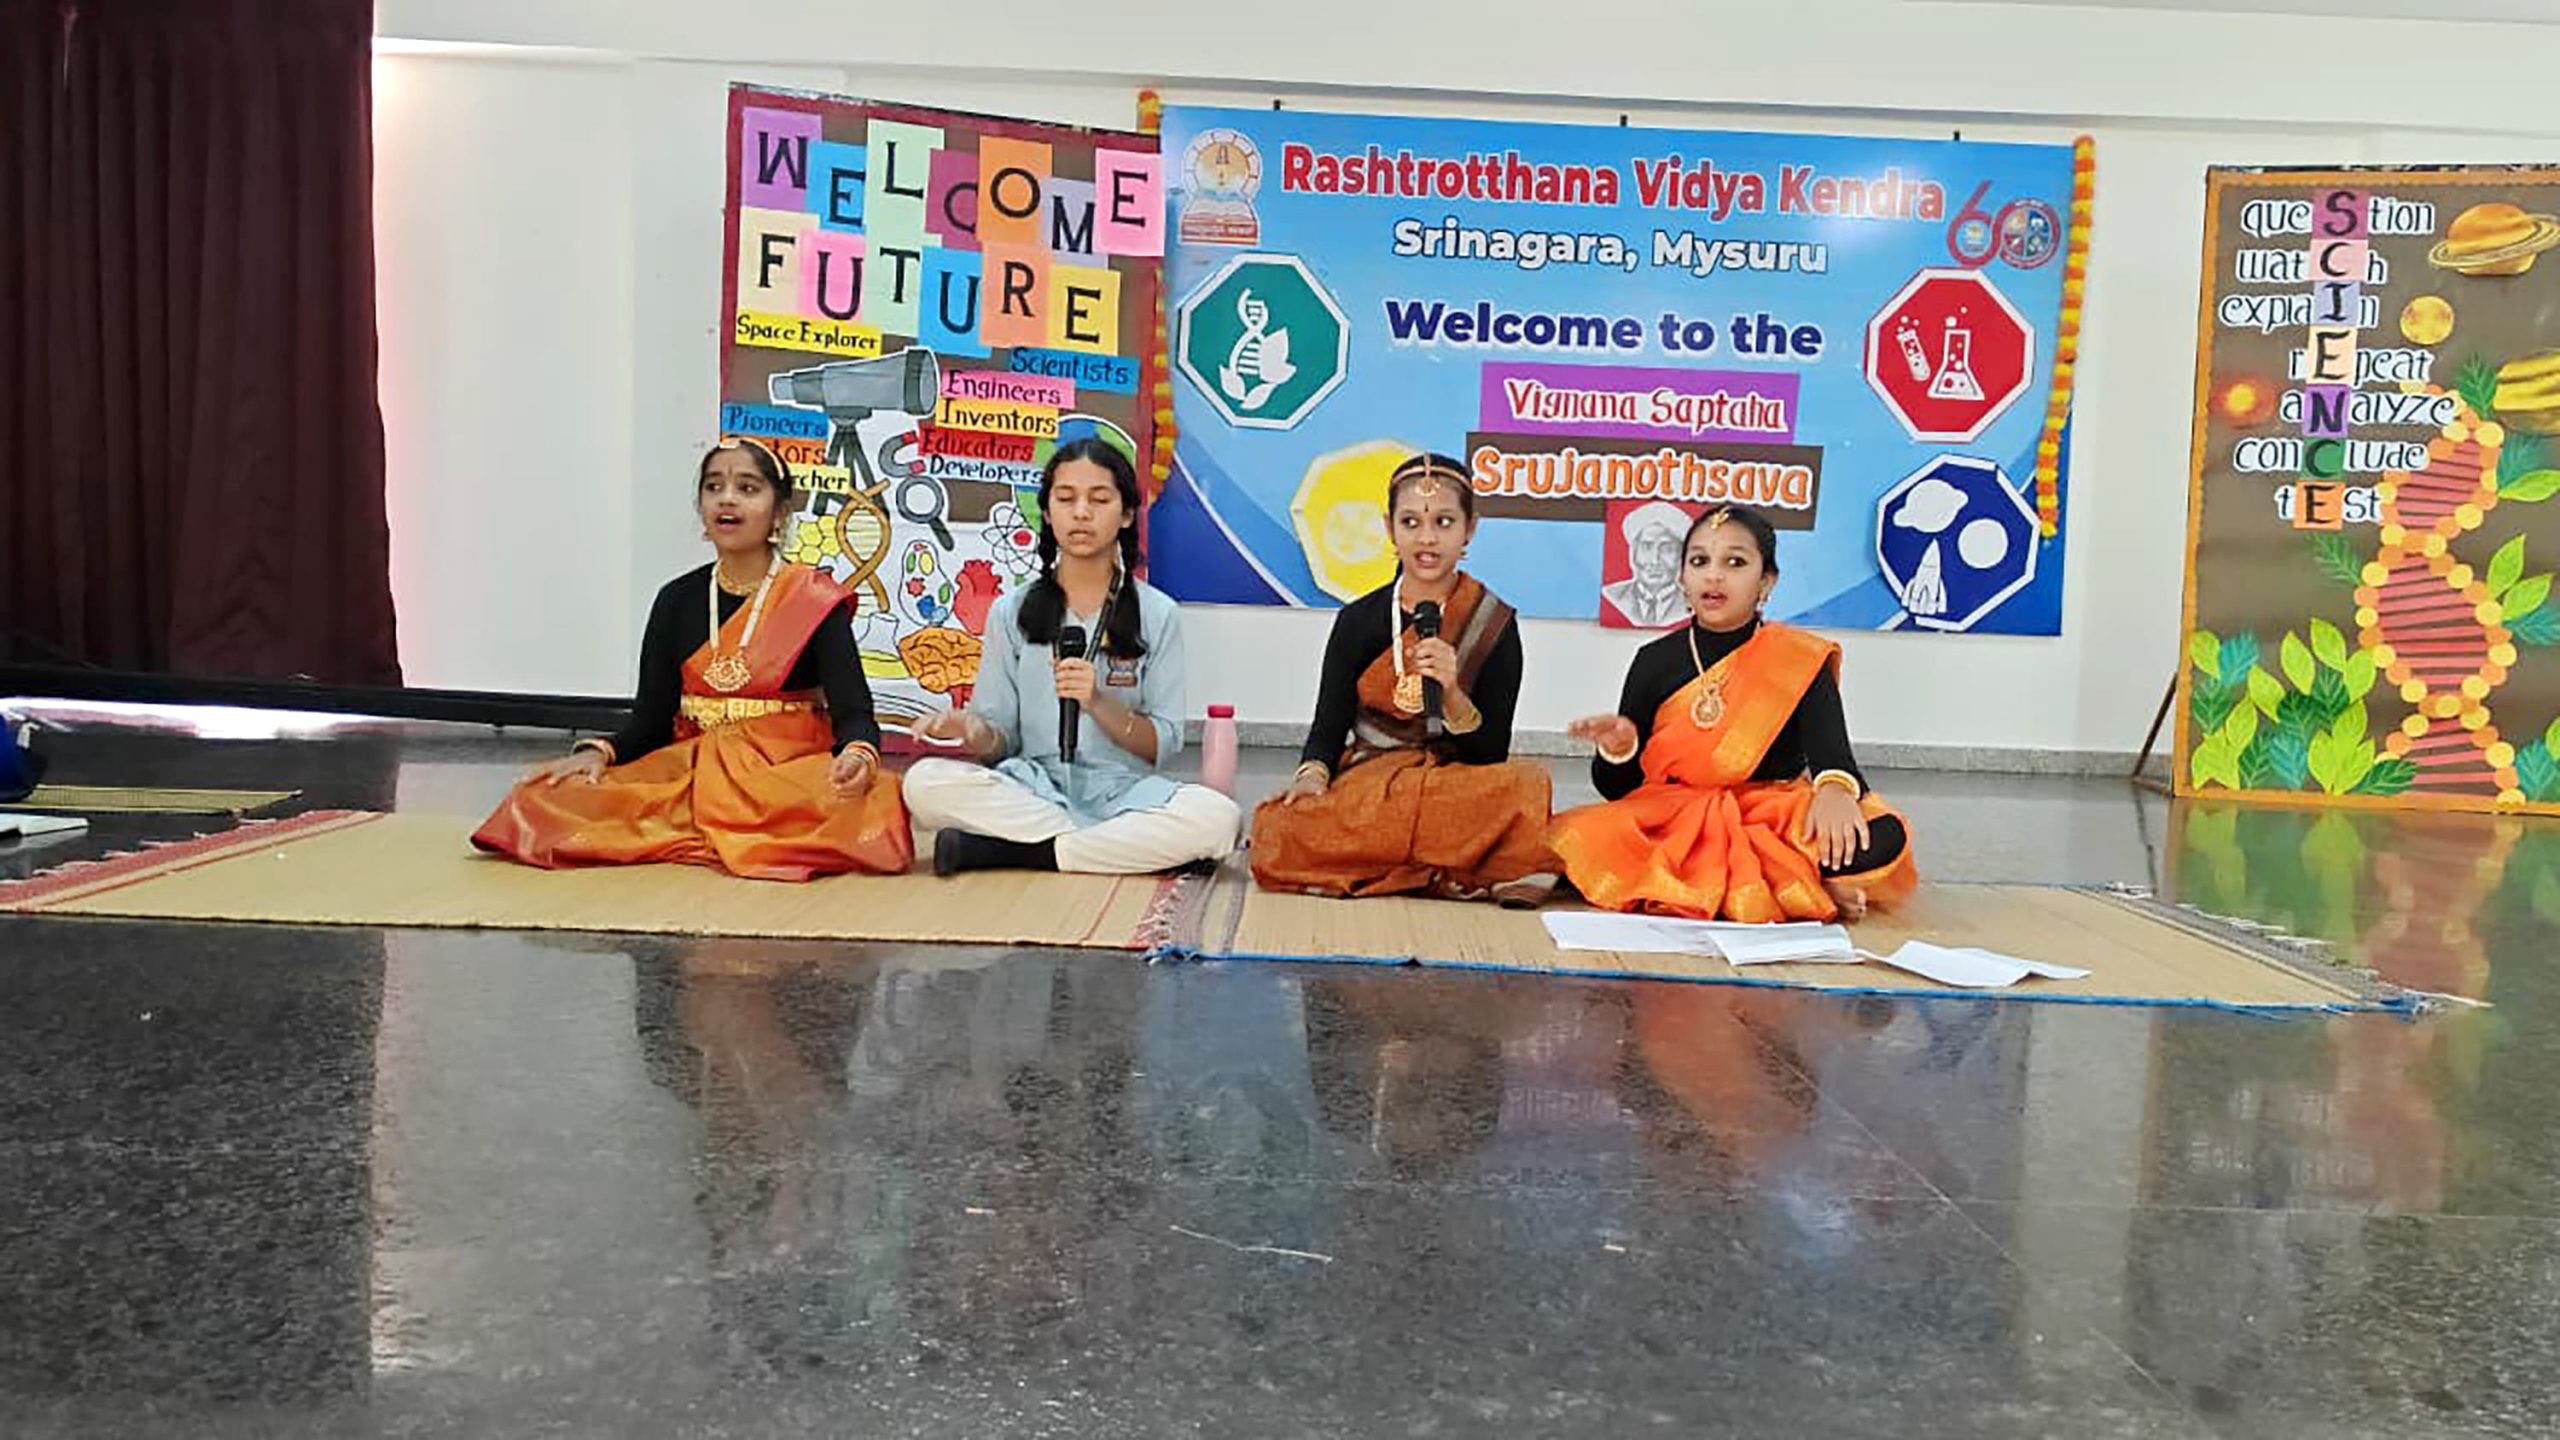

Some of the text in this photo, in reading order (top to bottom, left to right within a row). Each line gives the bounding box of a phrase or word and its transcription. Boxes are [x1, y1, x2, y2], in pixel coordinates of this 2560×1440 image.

[757, 130, 1148, 256] WELCOME
[1282, 145, 1946, 222] Rashtrotthana Vidya Kendra
[1392, 218, 1828, 277] Srinagara, Mysuru
[757, 233, 1102, 344] FUTURE
[737, 314, 877, 350] Space Explorer
[1386, 300, 1823, 357] Welcome to the
[946, 369, 1062, 405] Engineers
[1011, 348, 1129, 386] Scientists
[725, 404, 827, 437] Pioneers
[941, 397, 1057, 435] Inventors
[1507, 379, 1785, 432] Vignana Saptaha
[921, 427, 1034, 461] Educators
[930, 454, 1044, 485] Developers
[1472, 449, 1813, 505] Srujanothsava
